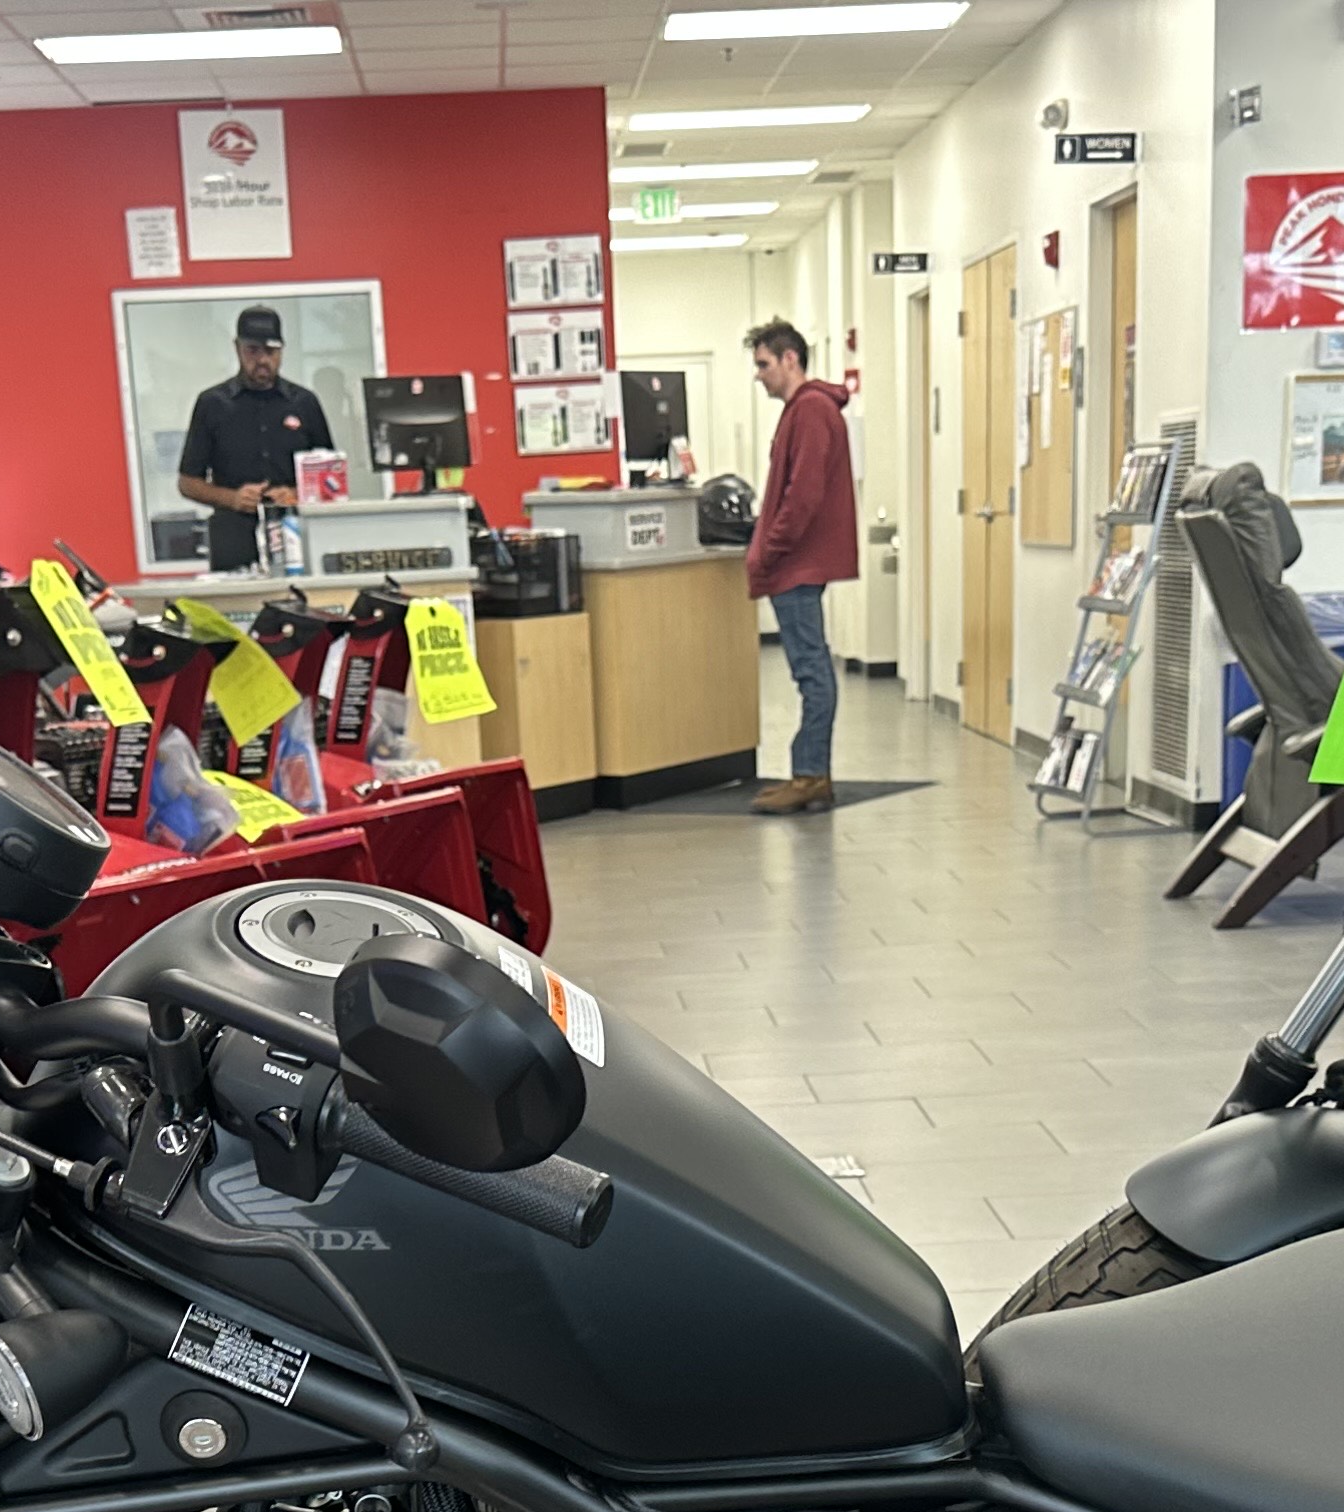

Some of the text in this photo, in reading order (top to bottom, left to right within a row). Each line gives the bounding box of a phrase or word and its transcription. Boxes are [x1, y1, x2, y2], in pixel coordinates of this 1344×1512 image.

[1084, 137, 1132, 149] WOMEN
[640, 189, 675, 218] EXIT
[1278, 209, 1307, 246] PEAK
[339, 550, 440, 572] SERVICE
[286, 1228, 390, 1251] NDA
